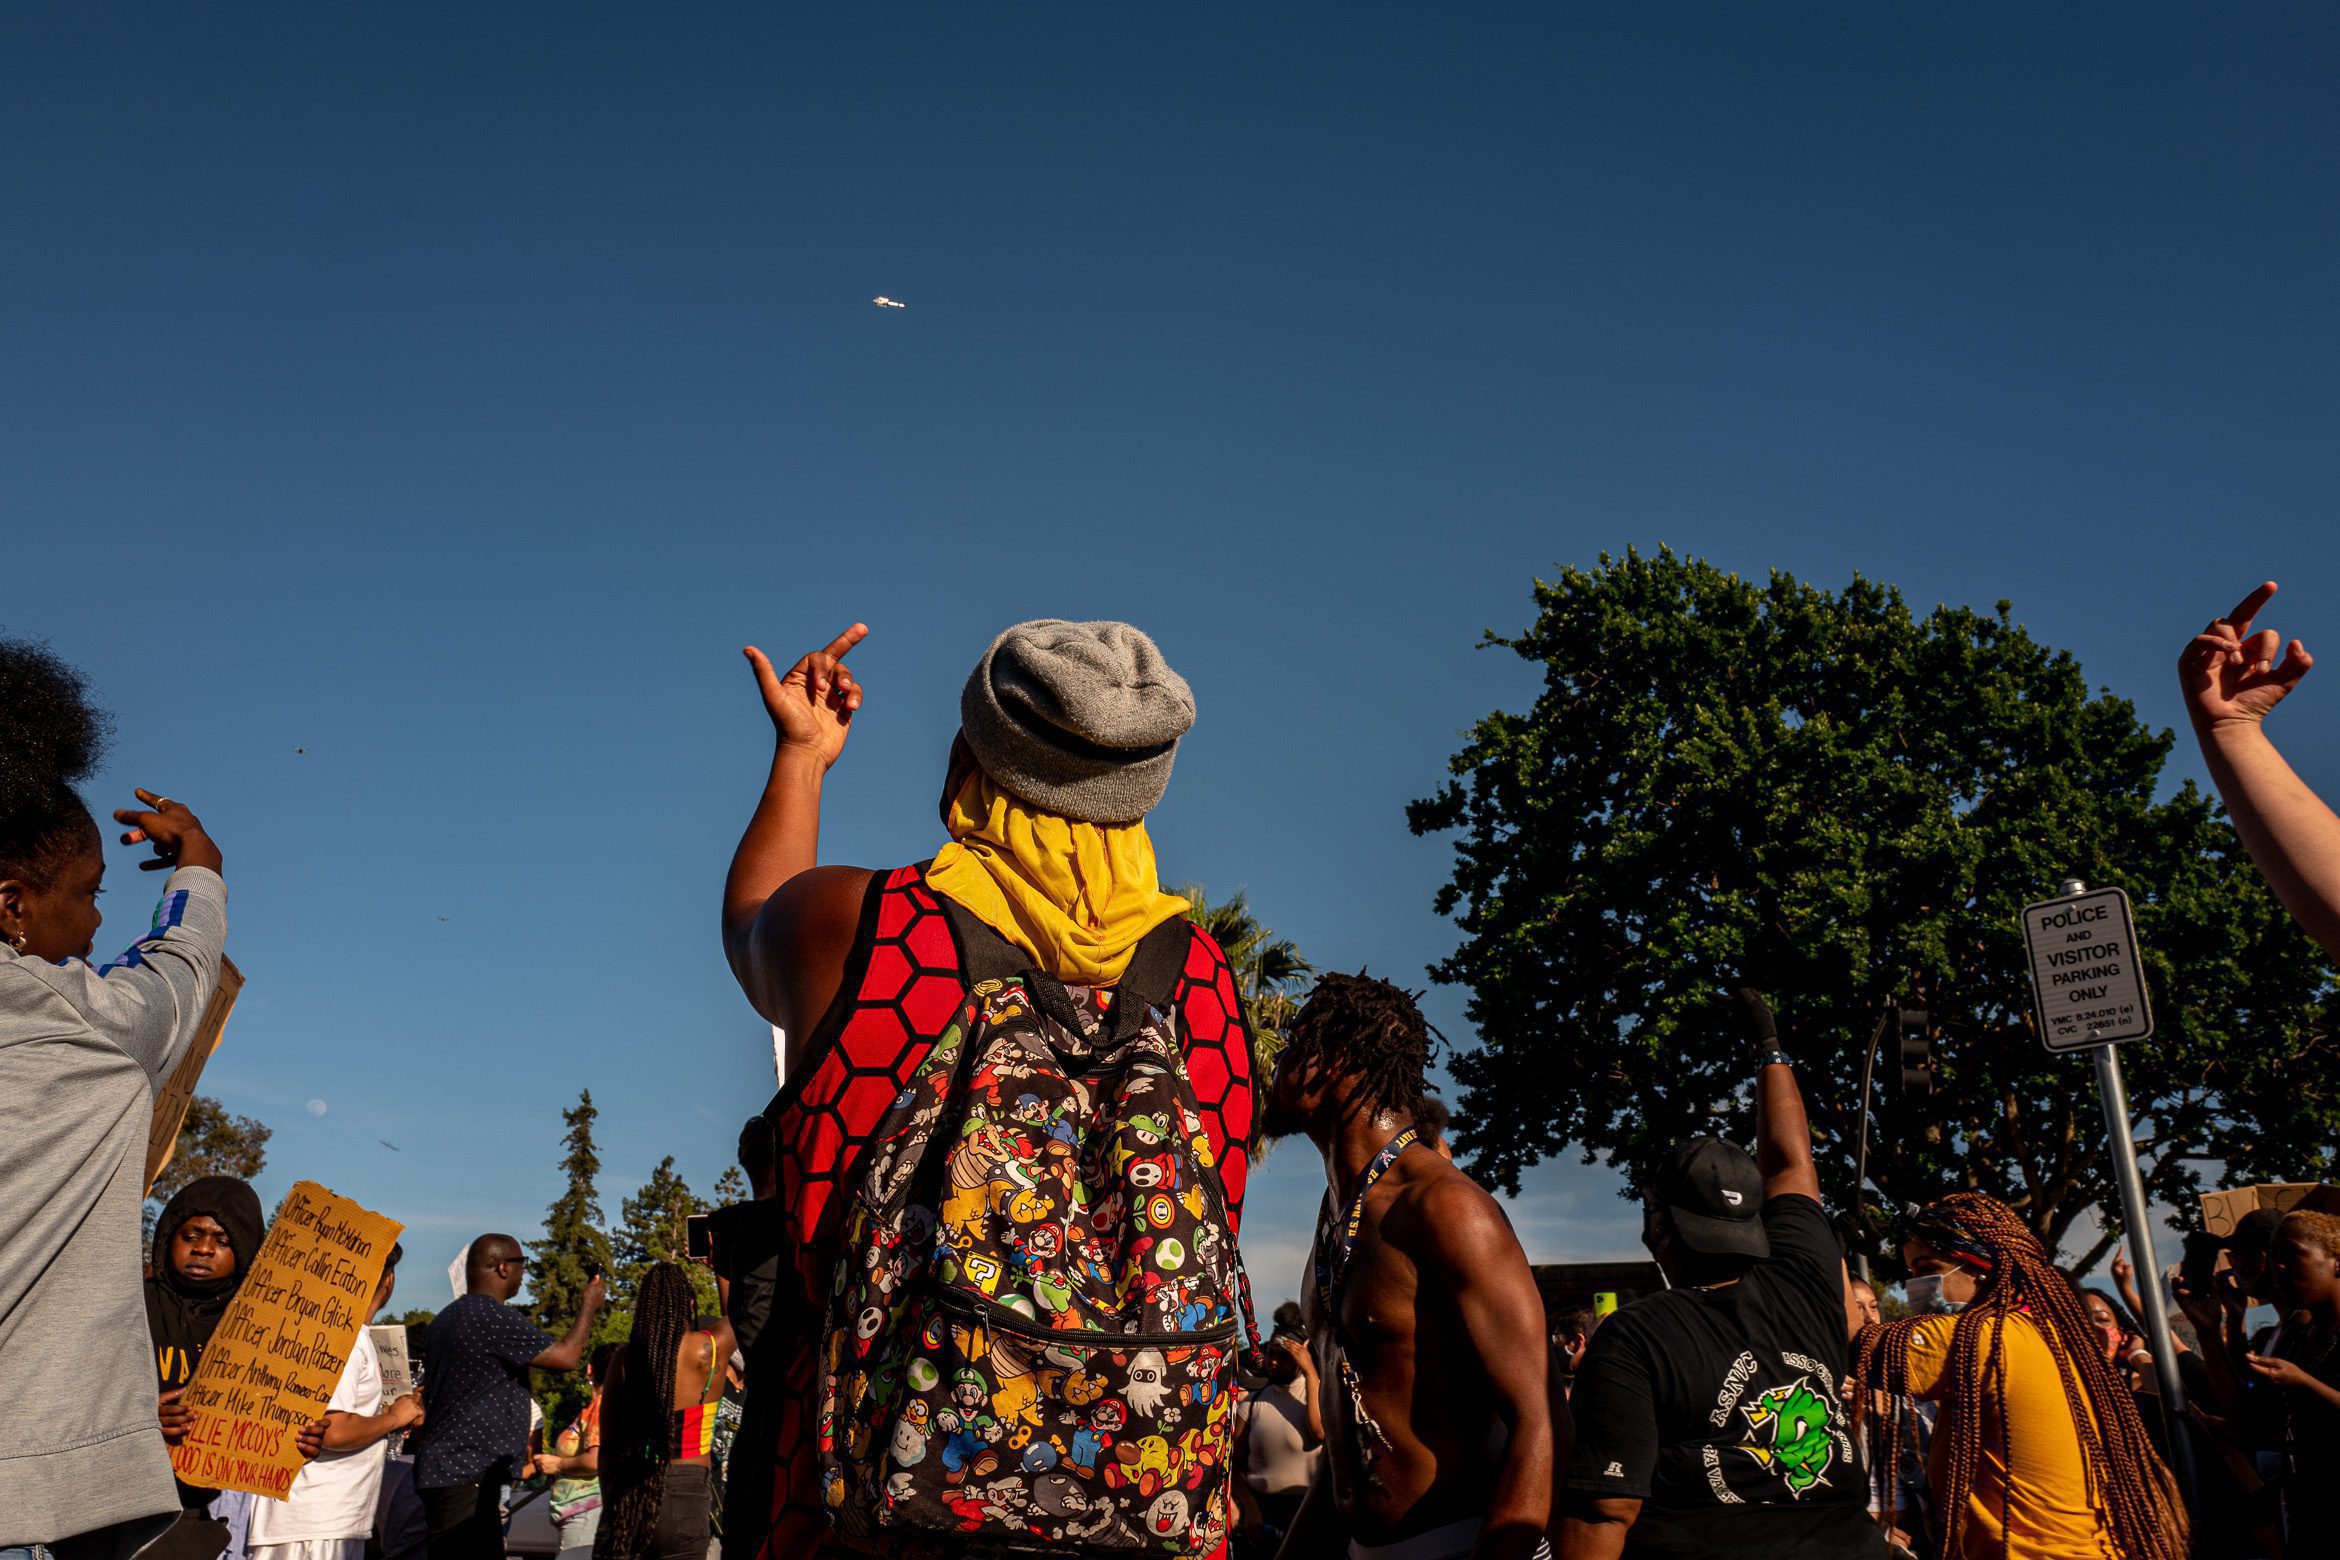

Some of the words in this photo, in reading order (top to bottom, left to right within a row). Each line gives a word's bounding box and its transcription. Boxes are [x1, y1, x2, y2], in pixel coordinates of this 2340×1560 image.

[2041, 905, 2108, 931] POLICE
[2066, 930, 2092, 944] AND
[2046, 942, 2120, 968] VISITOR
[2052, 963, 2121, 986] PARKING
[2069, 985, 2108, 1002] ONLY
[2051, 1015, 2073, 1026] VMC
[2076, 1007, 2116, 1022] 8.24.010
[2057, 1025, 2077, 1036] CVC
[284, 1192, 317, 1228] Officer
[313, 1206, 336, 1243] Ryan
[263, 1226, 305, 1270] Officer
[331, 1258, 367, 1299] Eaton
[243, 1263, 287, 1305] Officer
[285, 1280, 321, 1326] Bryan
[322, 1296, 354, 1333] Glick
[220, 1300, 271, 1349] Officer
[268, 1317, 309, 1366] Jordan
[306, 1331, 345, 1375] Patzer
[198, 1344, 245, 1382] Officer
[240, 1357, 283, 1400] Anthony
[186, 1380, 224, 1408] Officer
[1709, 1350, 1758, 1428] ASNVC
[201, 1451, 217, 1477] IS
[216, 1455, 235, 1483] ON
[234, 1458, 260, 1488] YOUR
[258, 1462, 294, 1493] HANDS
